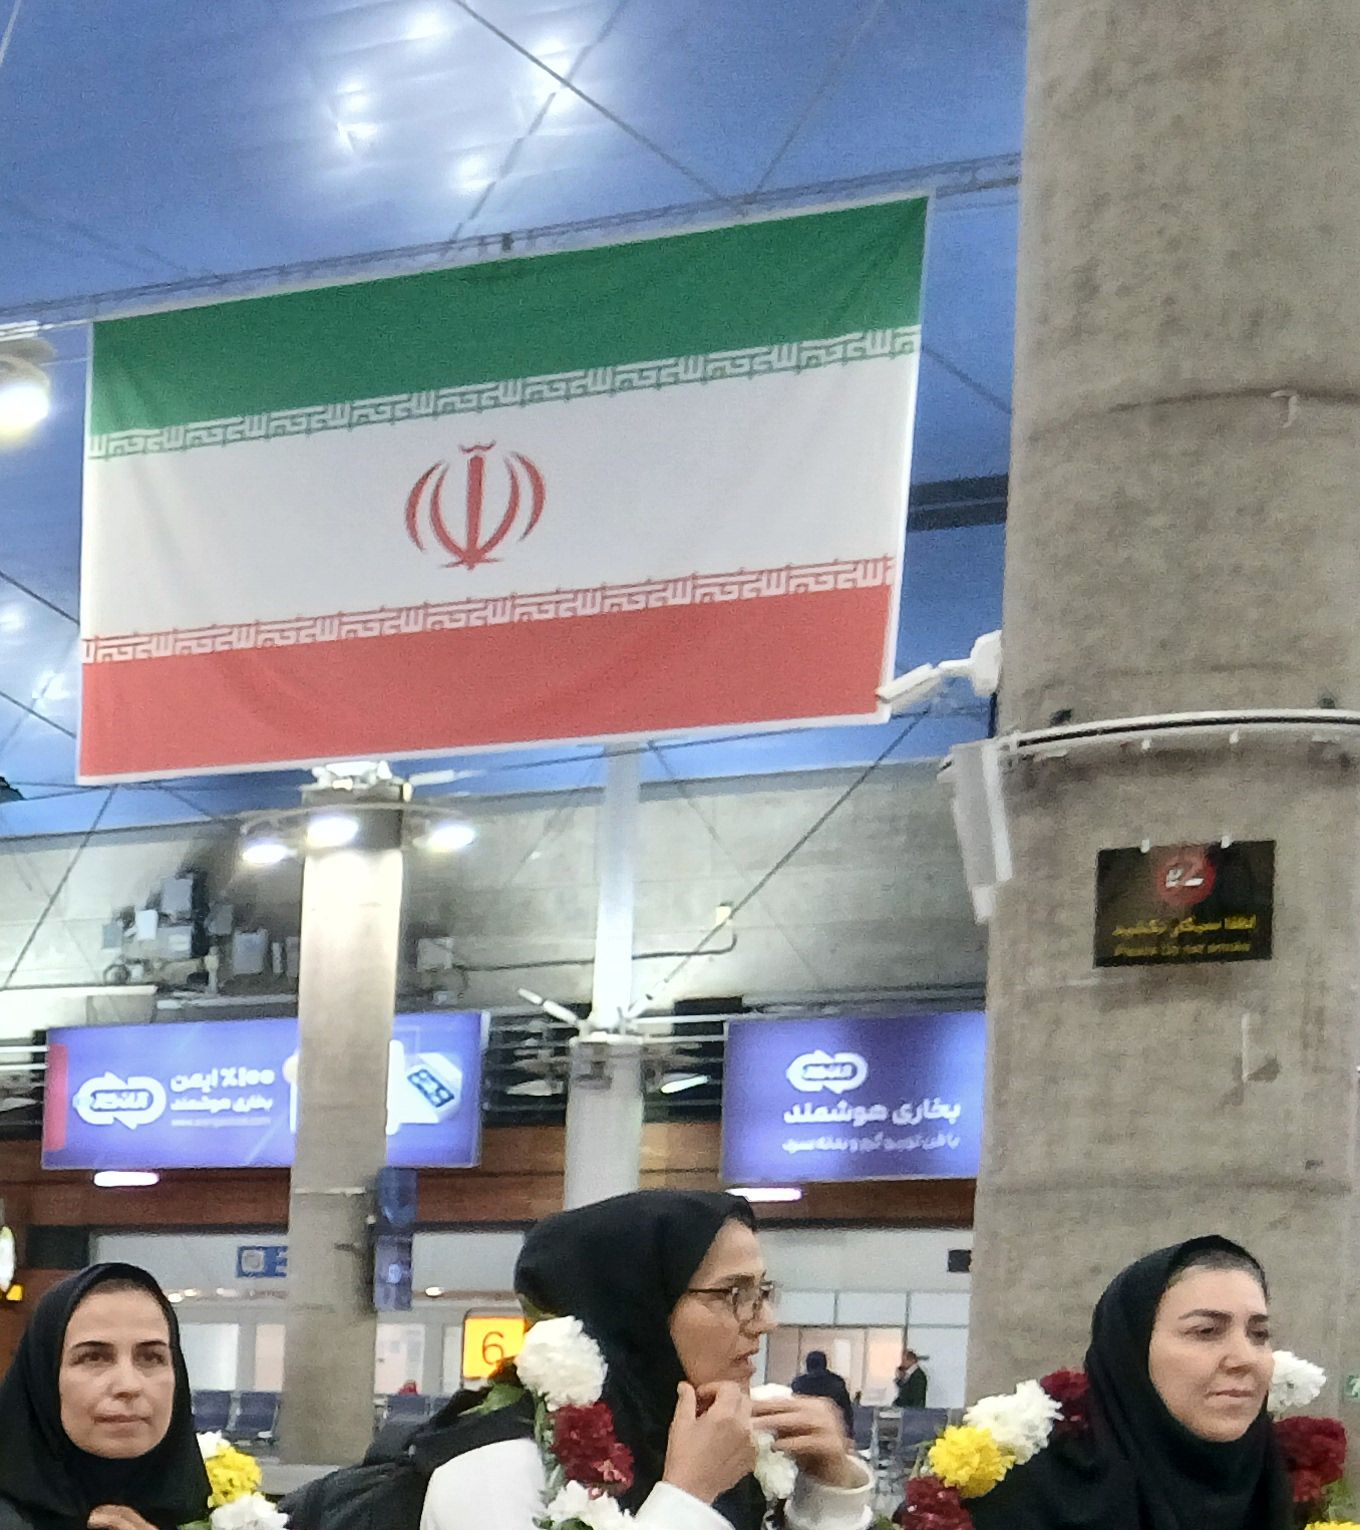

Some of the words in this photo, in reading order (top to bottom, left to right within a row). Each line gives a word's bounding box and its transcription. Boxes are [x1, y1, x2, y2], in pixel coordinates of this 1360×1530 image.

[783, 1099, 888, 1128] هوشمند
[892, 1097, 961, 1126] بخاری
[482, 1331, 504, 1365] 6
